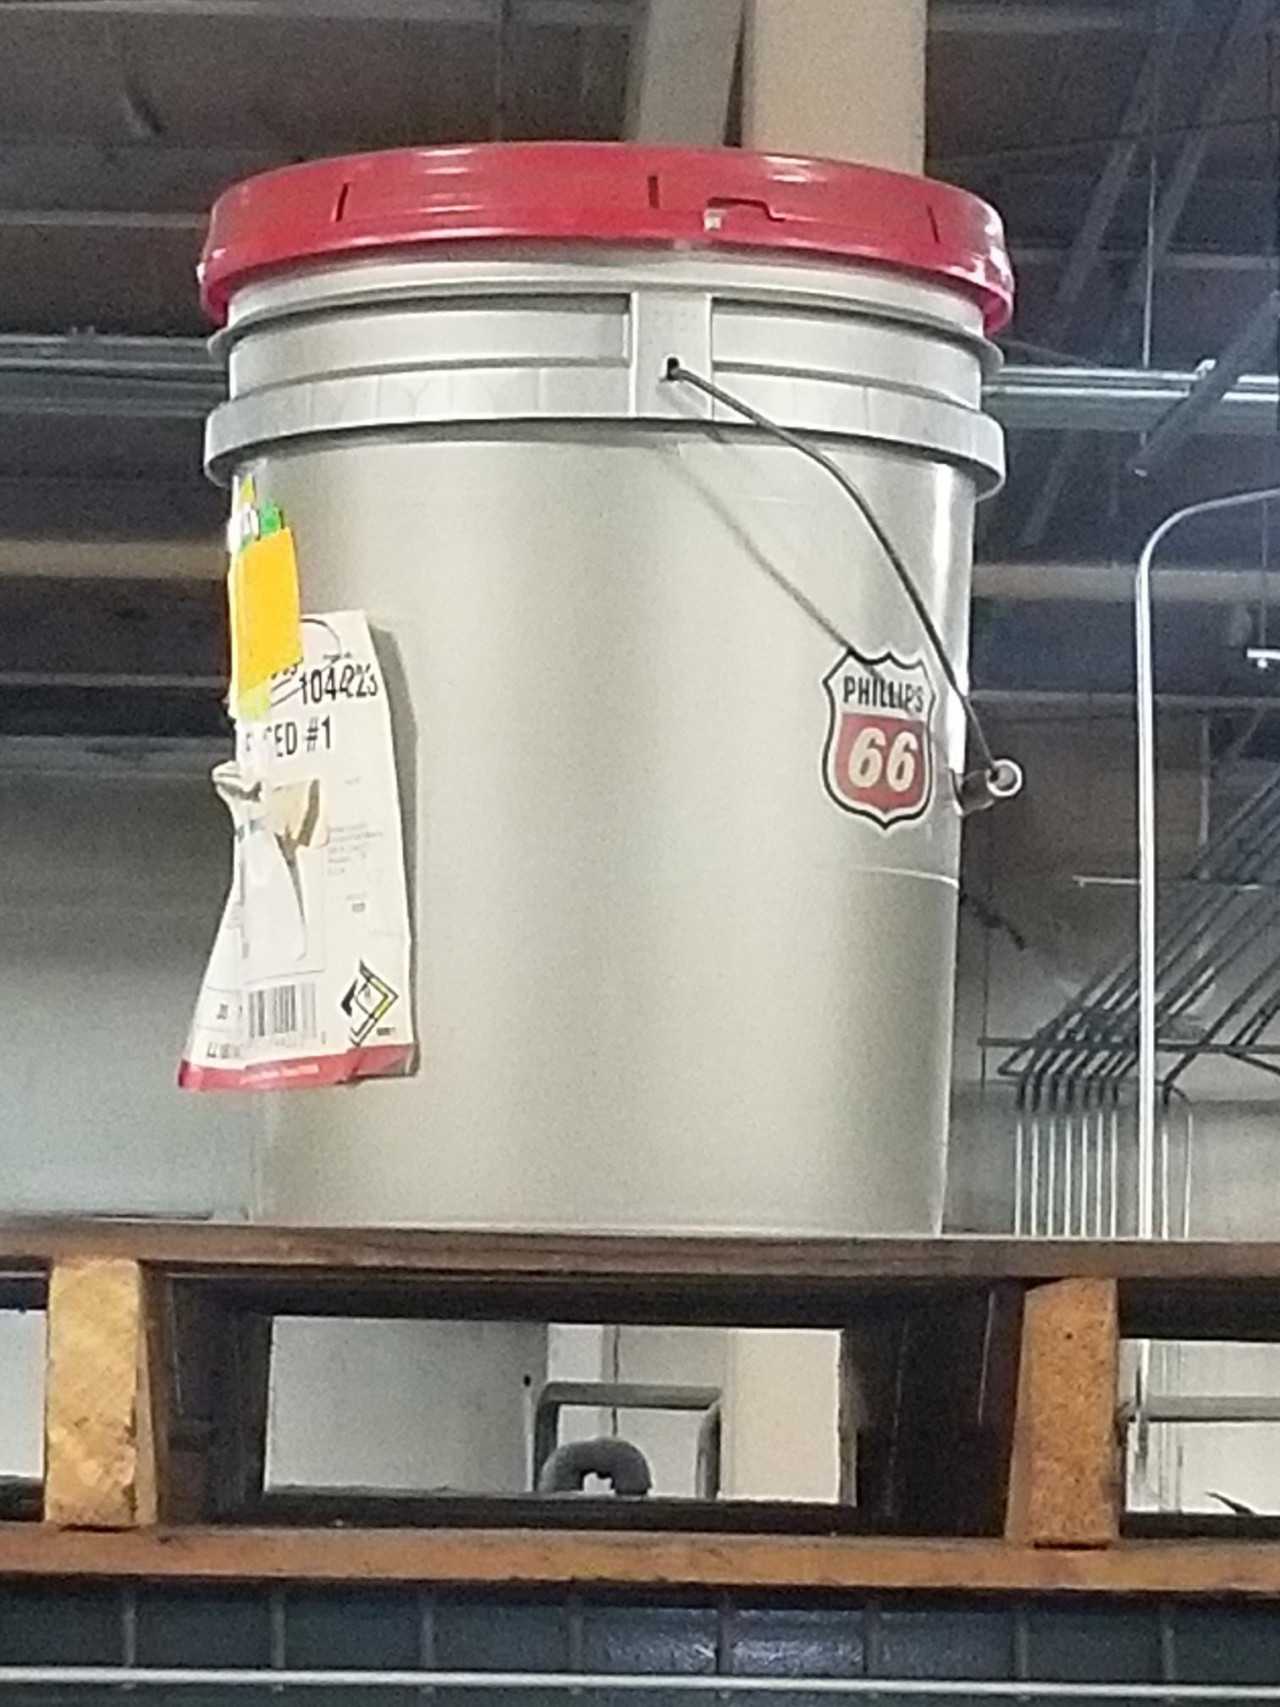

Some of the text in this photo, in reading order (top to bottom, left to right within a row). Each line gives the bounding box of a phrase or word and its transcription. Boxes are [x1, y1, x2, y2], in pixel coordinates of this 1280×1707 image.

[843, 675, 925, 713] PHILLIPS
[305, 714, 331, 752] #1
[848, 726, 919, 792] 66
